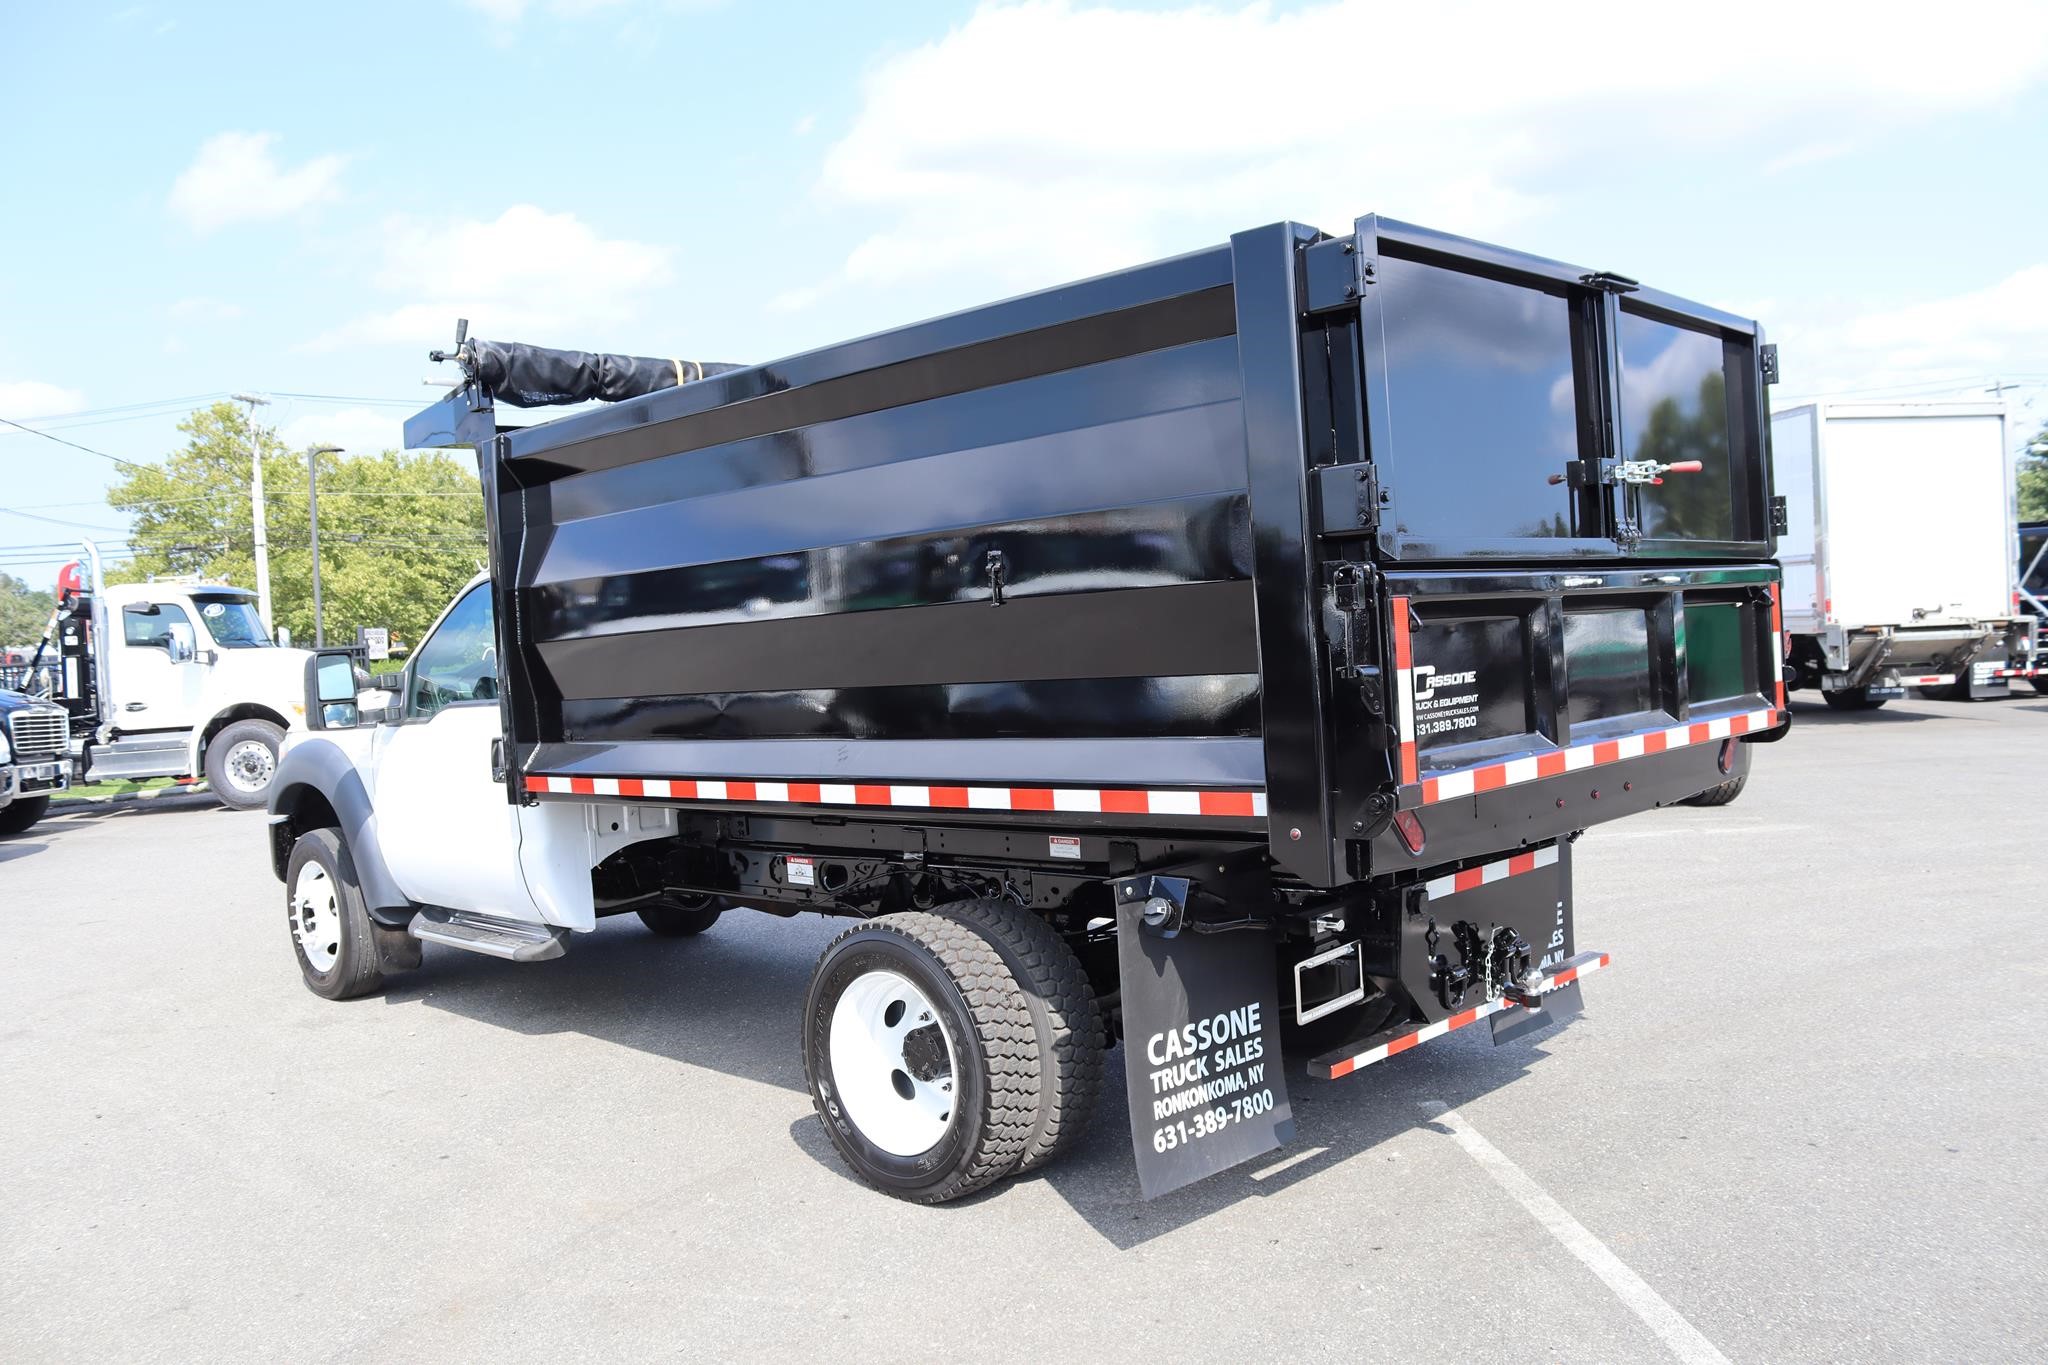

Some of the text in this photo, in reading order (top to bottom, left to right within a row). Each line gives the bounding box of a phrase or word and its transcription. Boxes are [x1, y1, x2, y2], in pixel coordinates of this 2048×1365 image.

[1413, 665, 1477, 700] CASSONE
[1433, 700, 1439, 708] &
[1439, 694, 1479, 707] EQUIPMENT
[1147, 1002, 1262, 1066] CASSONE
[1150, 1037, 1264, 1095] TRUCK SALES
[1153, 1063, 1265, 1121] RONKONKOMA, NY
[1153, 1088, 1274, 1154] 631-389-7800
